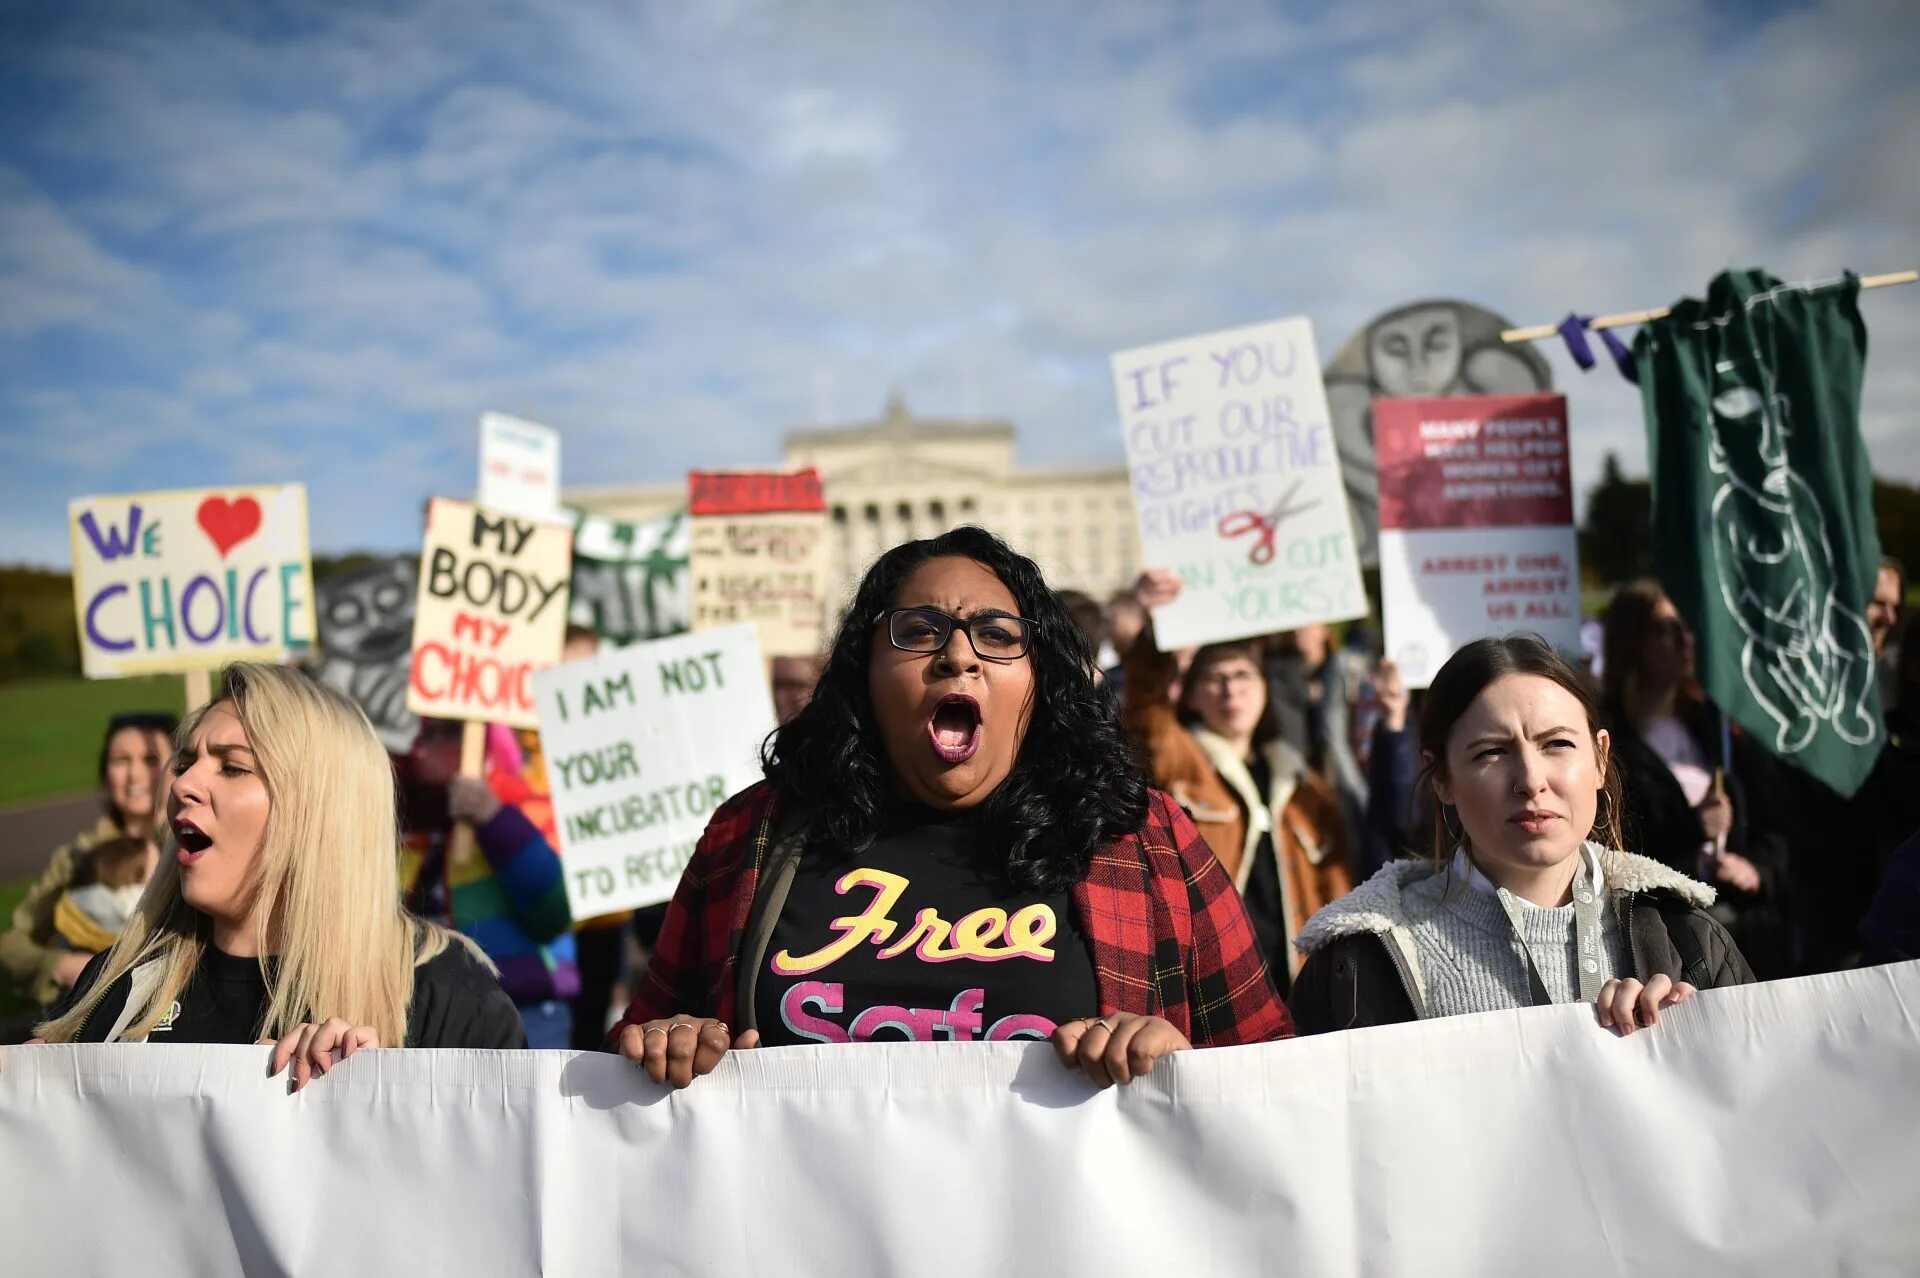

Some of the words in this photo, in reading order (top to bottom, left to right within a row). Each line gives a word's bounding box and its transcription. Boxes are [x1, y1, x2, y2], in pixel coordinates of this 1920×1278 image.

[1127, 356, 1190, 413] IF
[1210, 339, 1297, 389] YOU
[1129, 414, 1197, 456] CUT
[1218, 395, 1299, 440] OUR
[1484, 417, 1560, 436] PEOPLE
[1484, 438, 1562, 457] HELPED
[472, 509, 536, 557] MY
[428, 546, 572, 624] BODY
[1178, 560, 1217, 592] AN
[1285, 531, 1347, 571] CUT
[1422, 554, 1507, 575] ARREST
[1483, 577, 1569, 597] ARREST
[84, 562, 311, 655] CHOICE
[452, 611, 512, 649] MY
[1487, 602, 1518, 620] US
[409, 640, 538, 712] CHOIC
[555, 688, 569, 722] I
[582, 670, 637, 716] AM
[657, 651, 726, 696] NOT
[554, 740, 640, 791] YOUR
[564, 774, 728, 844] INCUBATOR
[574, 865, 616, 900] TO
[770, 867, 1057, 976] Free
